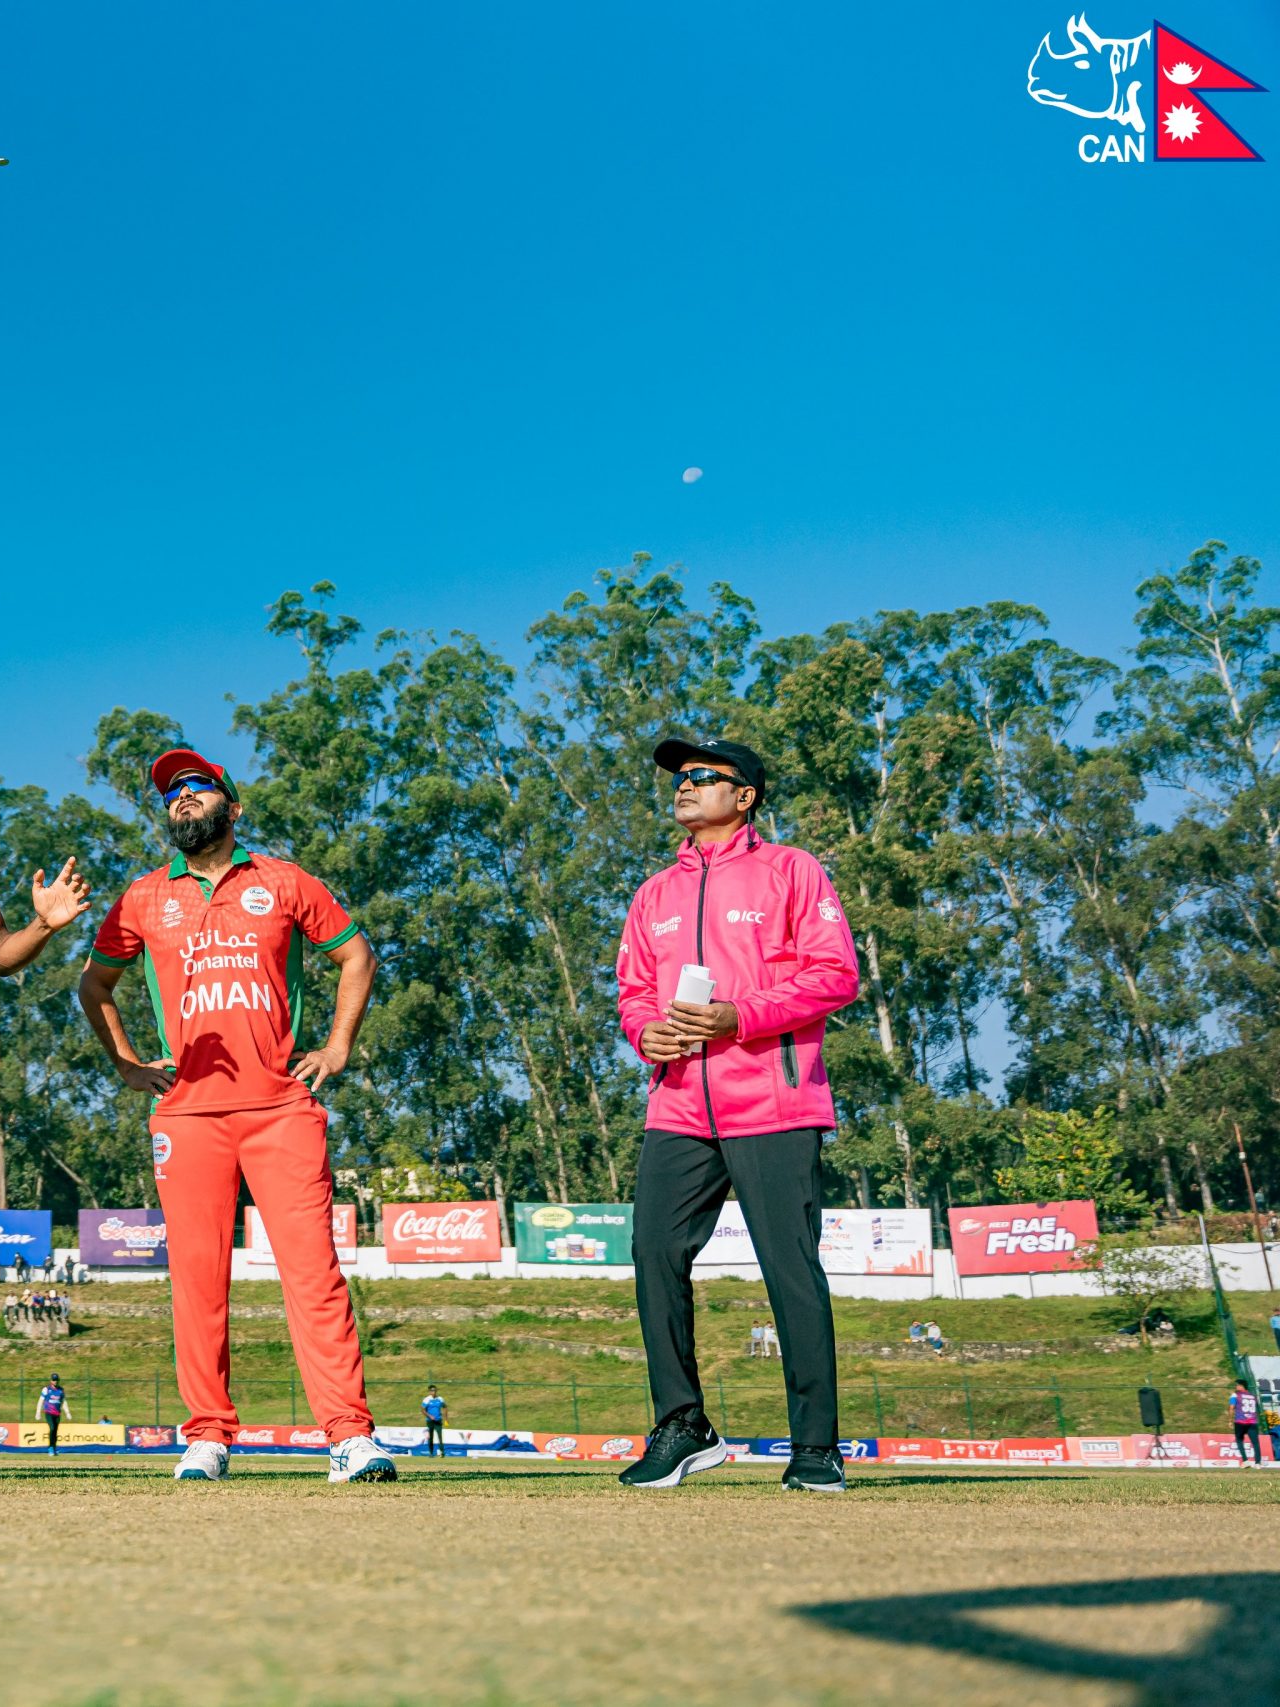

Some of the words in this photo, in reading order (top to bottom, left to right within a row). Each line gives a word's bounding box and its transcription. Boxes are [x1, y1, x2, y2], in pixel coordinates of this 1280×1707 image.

[741, 910, 766, 924] ICC
[184, 952, 259, 976] Omantel
[180, 981, 271, 1020] OMAN
[98, 1222, 167, 1241] Second
[392, 1208, 489, 1241] Coca-Cola
[1011, 1216, 1057, 1234] BAE
[986, 1227, 1076, 1255] Fresh
[42, 1432, 113, 1442] Fodmandu
